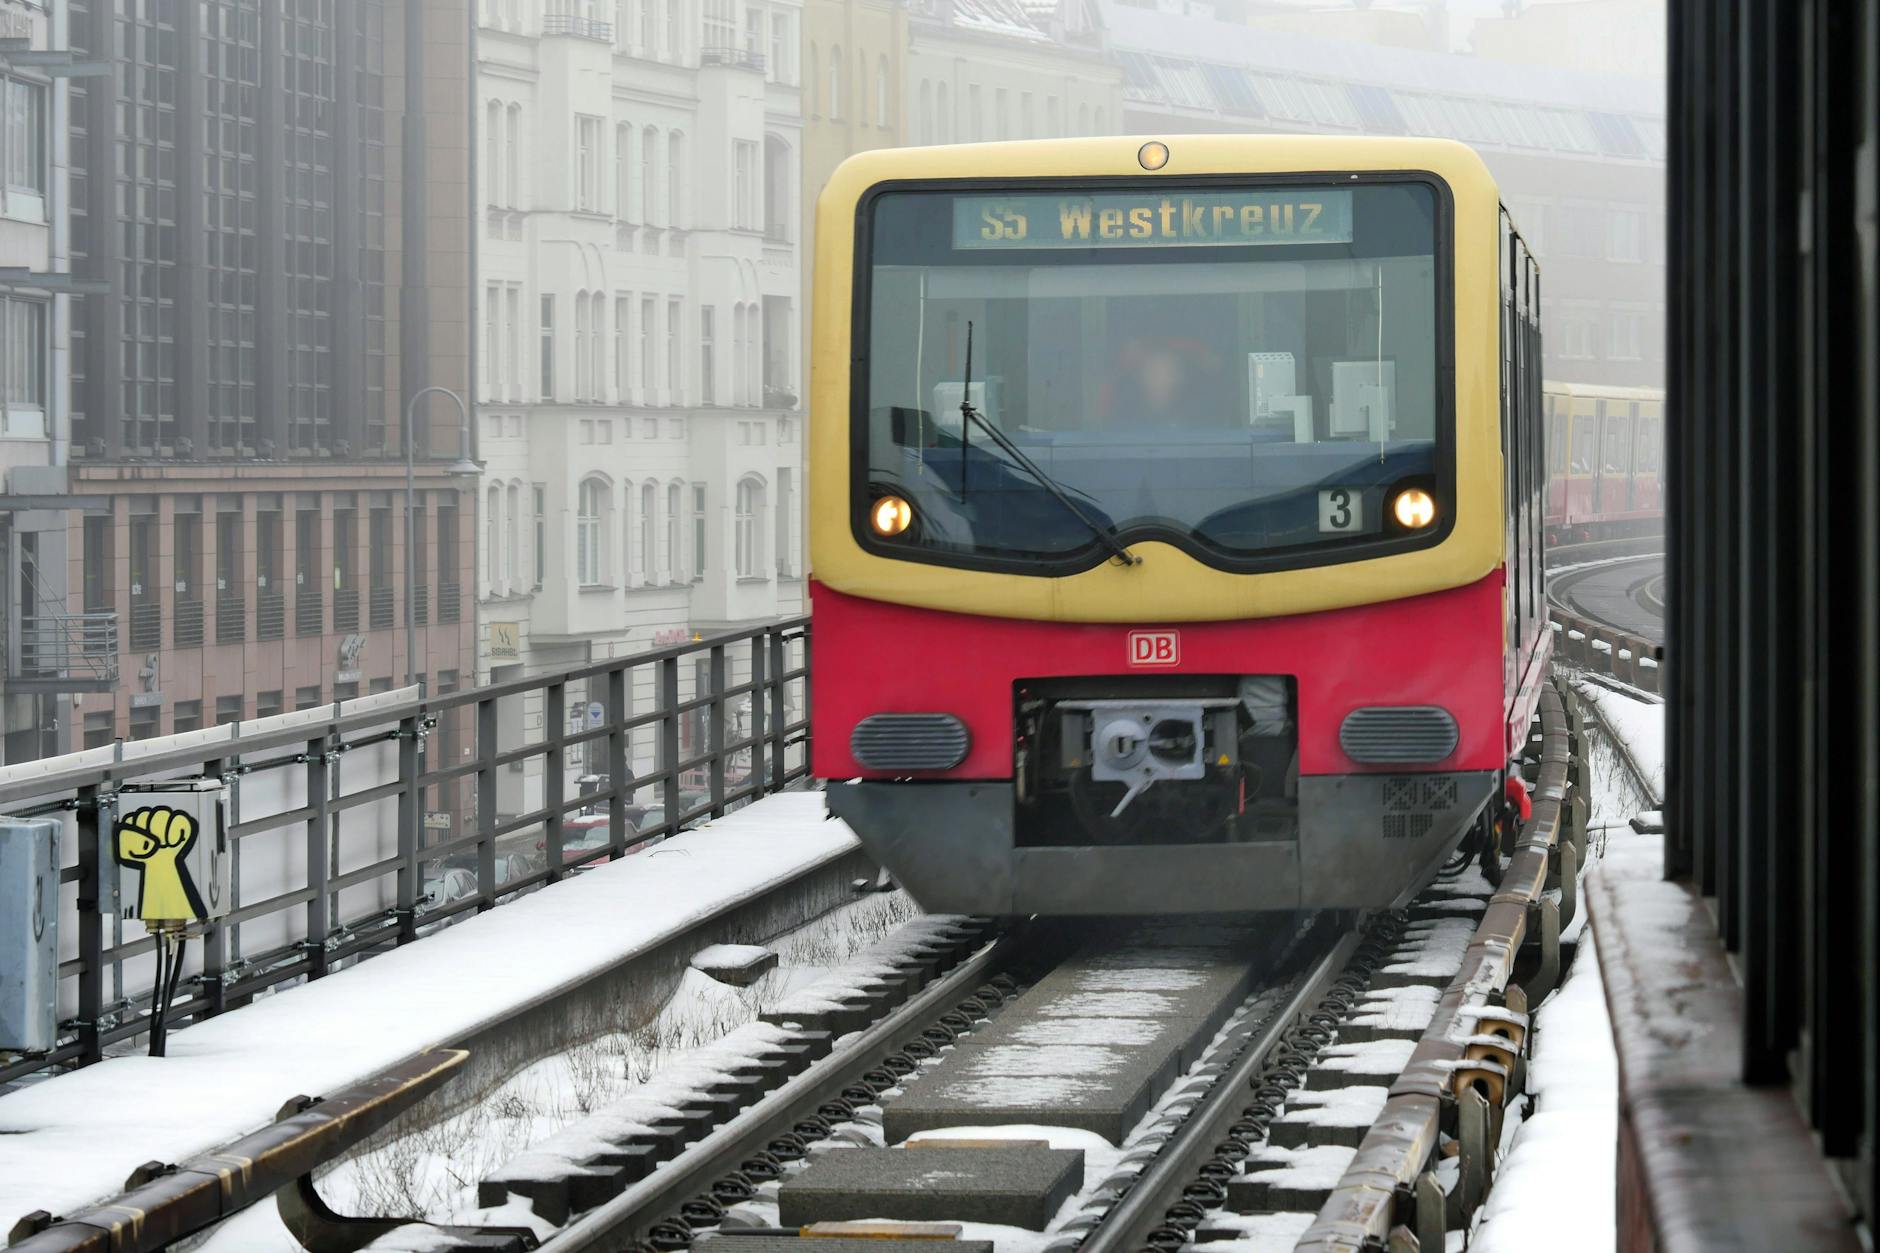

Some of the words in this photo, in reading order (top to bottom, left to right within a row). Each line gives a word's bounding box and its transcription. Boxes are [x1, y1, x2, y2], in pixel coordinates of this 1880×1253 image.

[981, 203, 1027, 240] S5
[1059, 200, 1324, 239] Westkreuz
[1329, 488, 1351, 529] 3
[1136, 637, 1172, 660] DB
